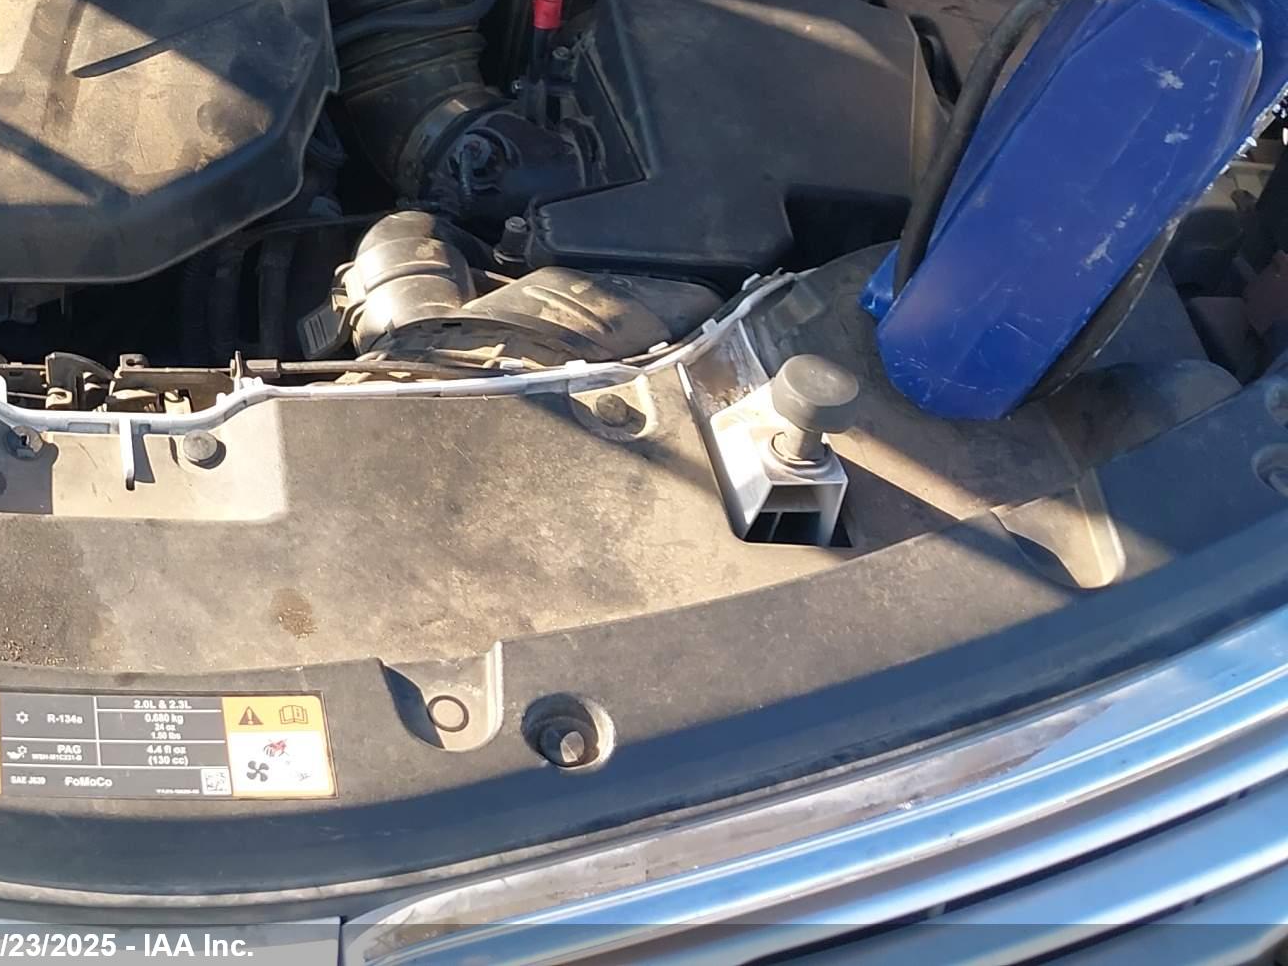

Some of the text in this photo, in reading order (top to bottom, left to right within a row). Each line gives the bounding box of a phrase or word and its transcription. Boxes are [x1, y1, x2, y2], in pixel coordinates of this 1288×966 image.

[134, 699, 192, 709] 2.0L & 2.3L
[47, 713, 83, 724] R-134a
[171, 713, 184, 725] kg
[57, 744, 82, 754] PAG
[146, 745, 163, 754] 4.4
[173, 746, 187, 754] oz
[148, 755, 189, 766] (130 cc)
[64, 776, 113, 787] FoMoCo
